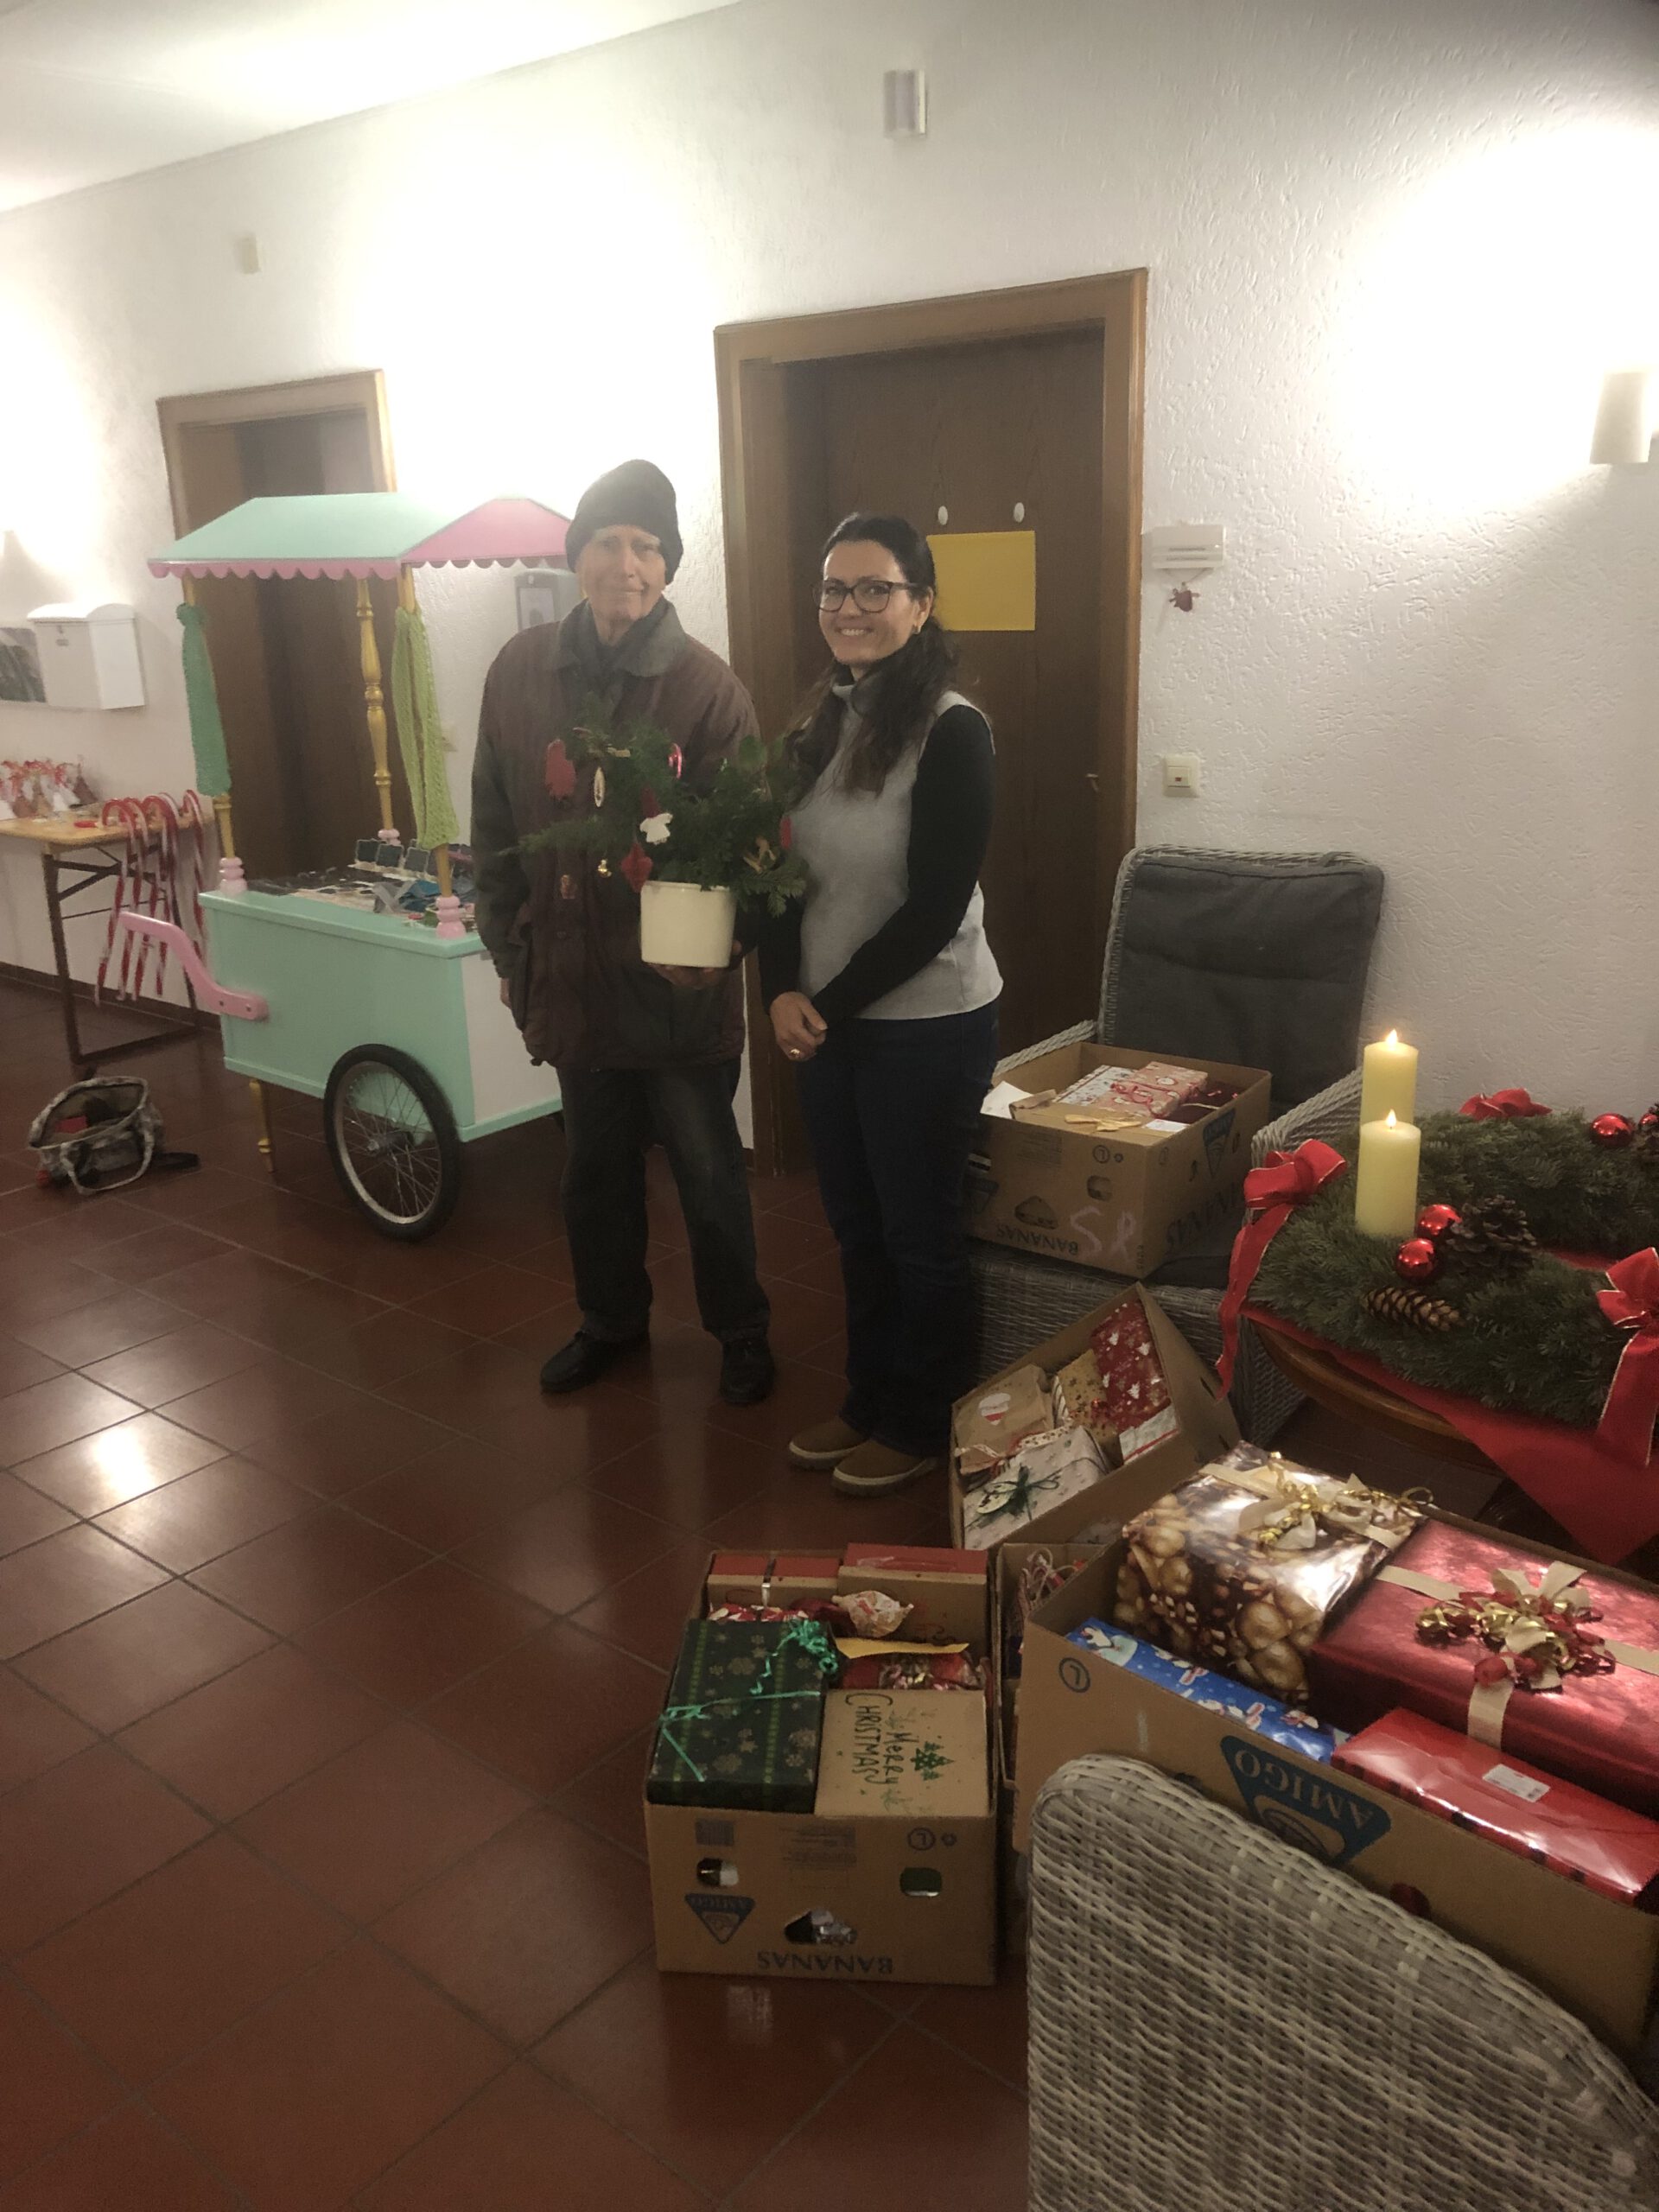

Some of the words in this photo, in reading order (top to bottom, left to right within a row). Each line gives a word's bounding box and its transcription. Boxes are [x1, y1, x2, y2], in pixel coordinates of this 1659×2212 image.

[995, 1224, 1079, 1255] BANANAS
[1235, 1747, 1373, 1832] AMIGO
[757, 1950, 893, 1974] BANANAS
